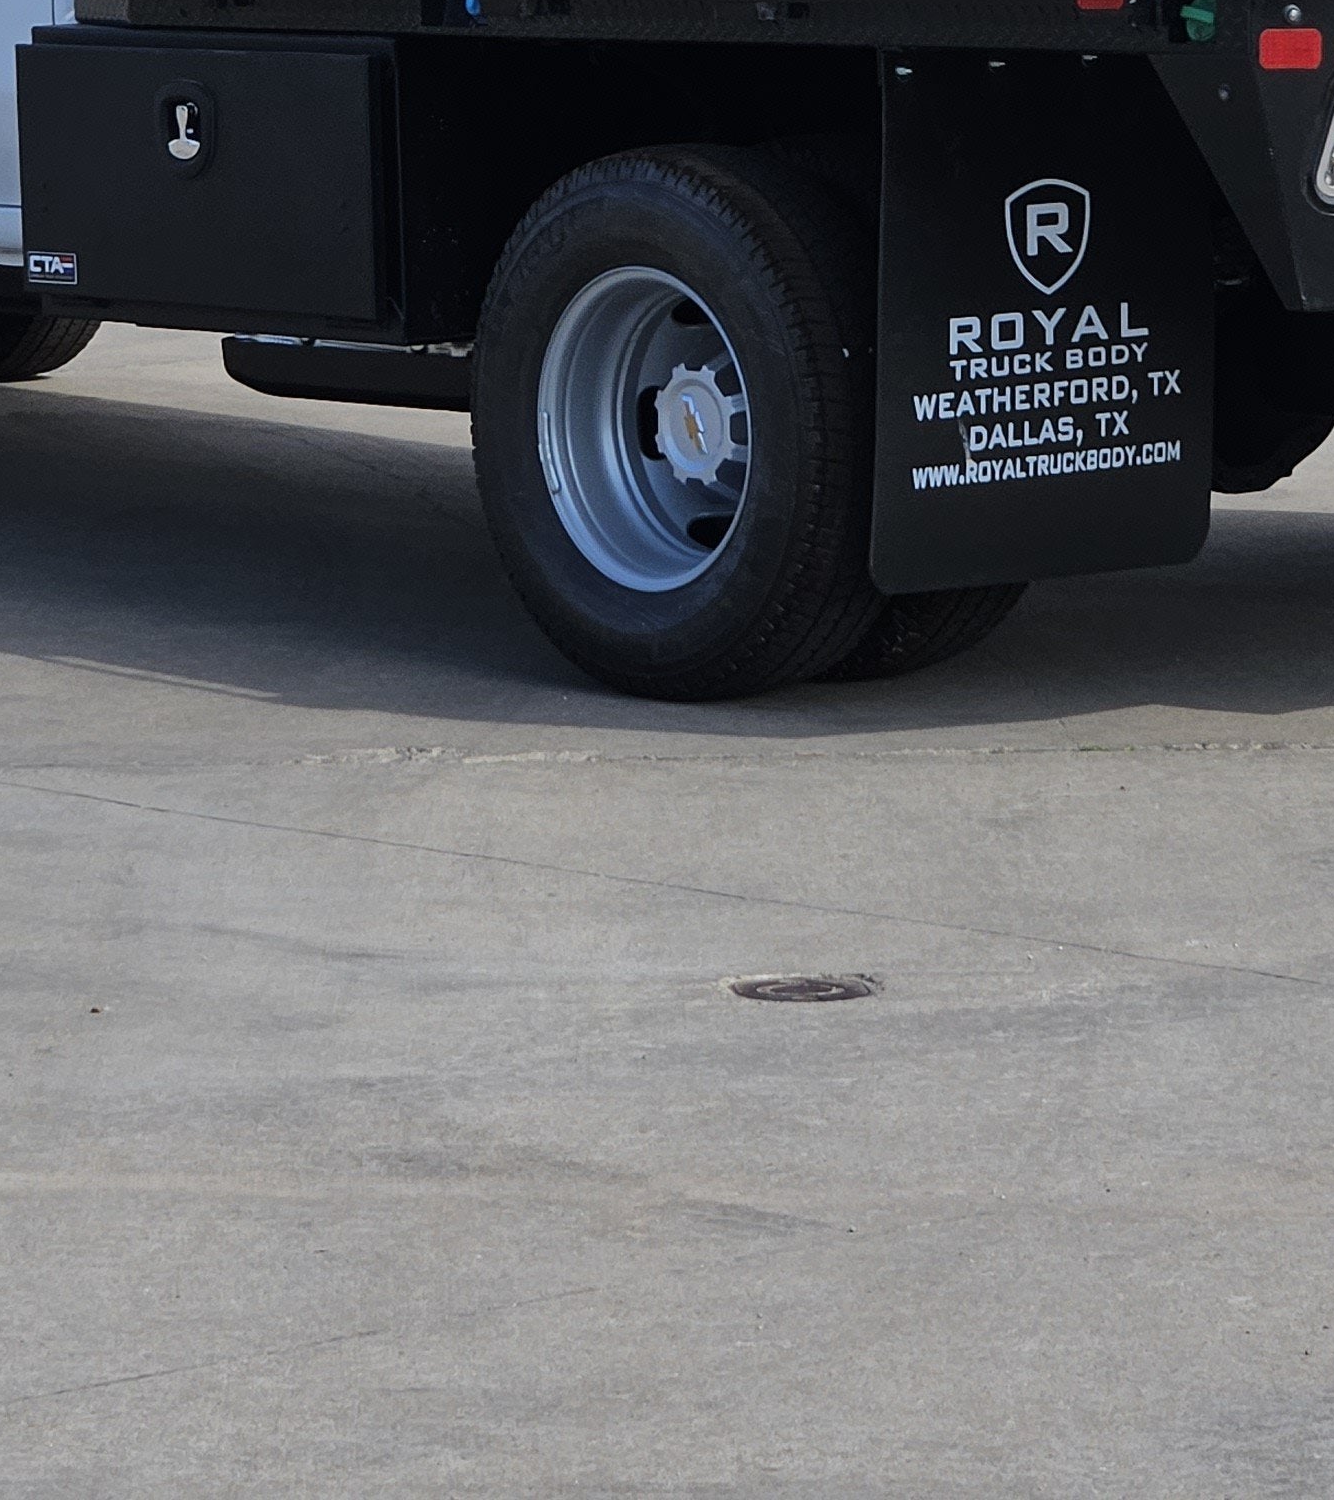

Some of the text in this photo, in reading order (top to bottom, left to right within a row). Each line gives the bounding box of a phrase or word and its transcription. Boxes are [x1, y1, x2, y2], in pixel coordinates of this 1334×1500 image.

[1026, 202, 1074, 256] R
[29, 255, 65, 274] CTA
[949, 302, 1149, 355] ROYAL
[950, 342, 1148, 382] TRUCK BODY
[913, 369, 1182, 422] WEATHERFORD, TX
[969, 410, 1130, 452] DALLAS, TX
[912, 439, 1182, 490] WWW.ROYALTRUCKBODY.COM
